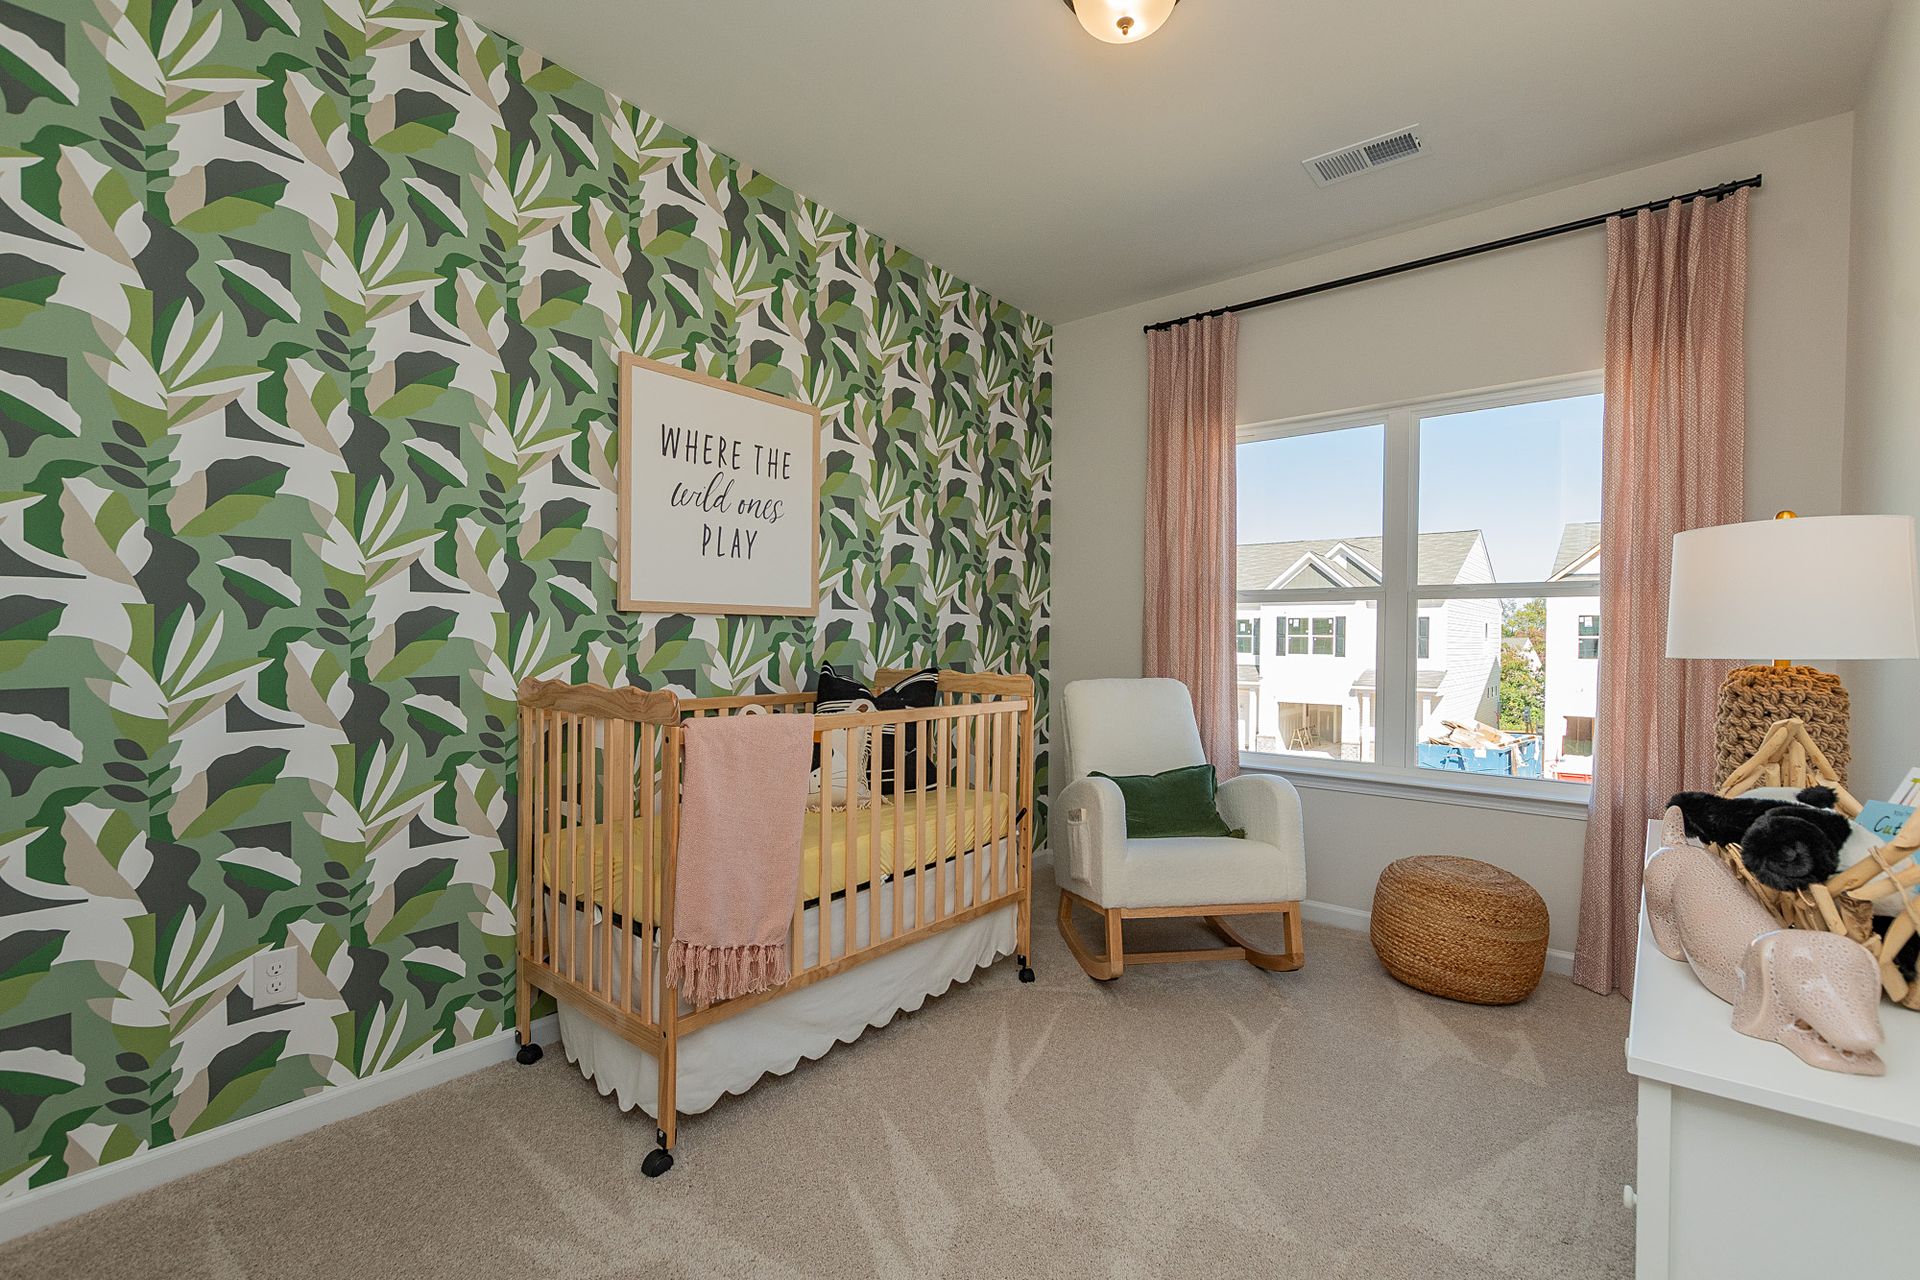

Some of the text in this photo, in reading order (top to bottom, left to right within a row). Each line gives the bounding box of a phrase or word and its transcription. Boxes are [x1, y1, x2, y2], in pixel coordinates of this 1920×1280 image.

[661, 423, 792, 480] WHERE THE
[670, 471, 785, 524] wild ones
[702, 523, 758, 560] PLAY
[1873, 815, 1904, 836] Cut
